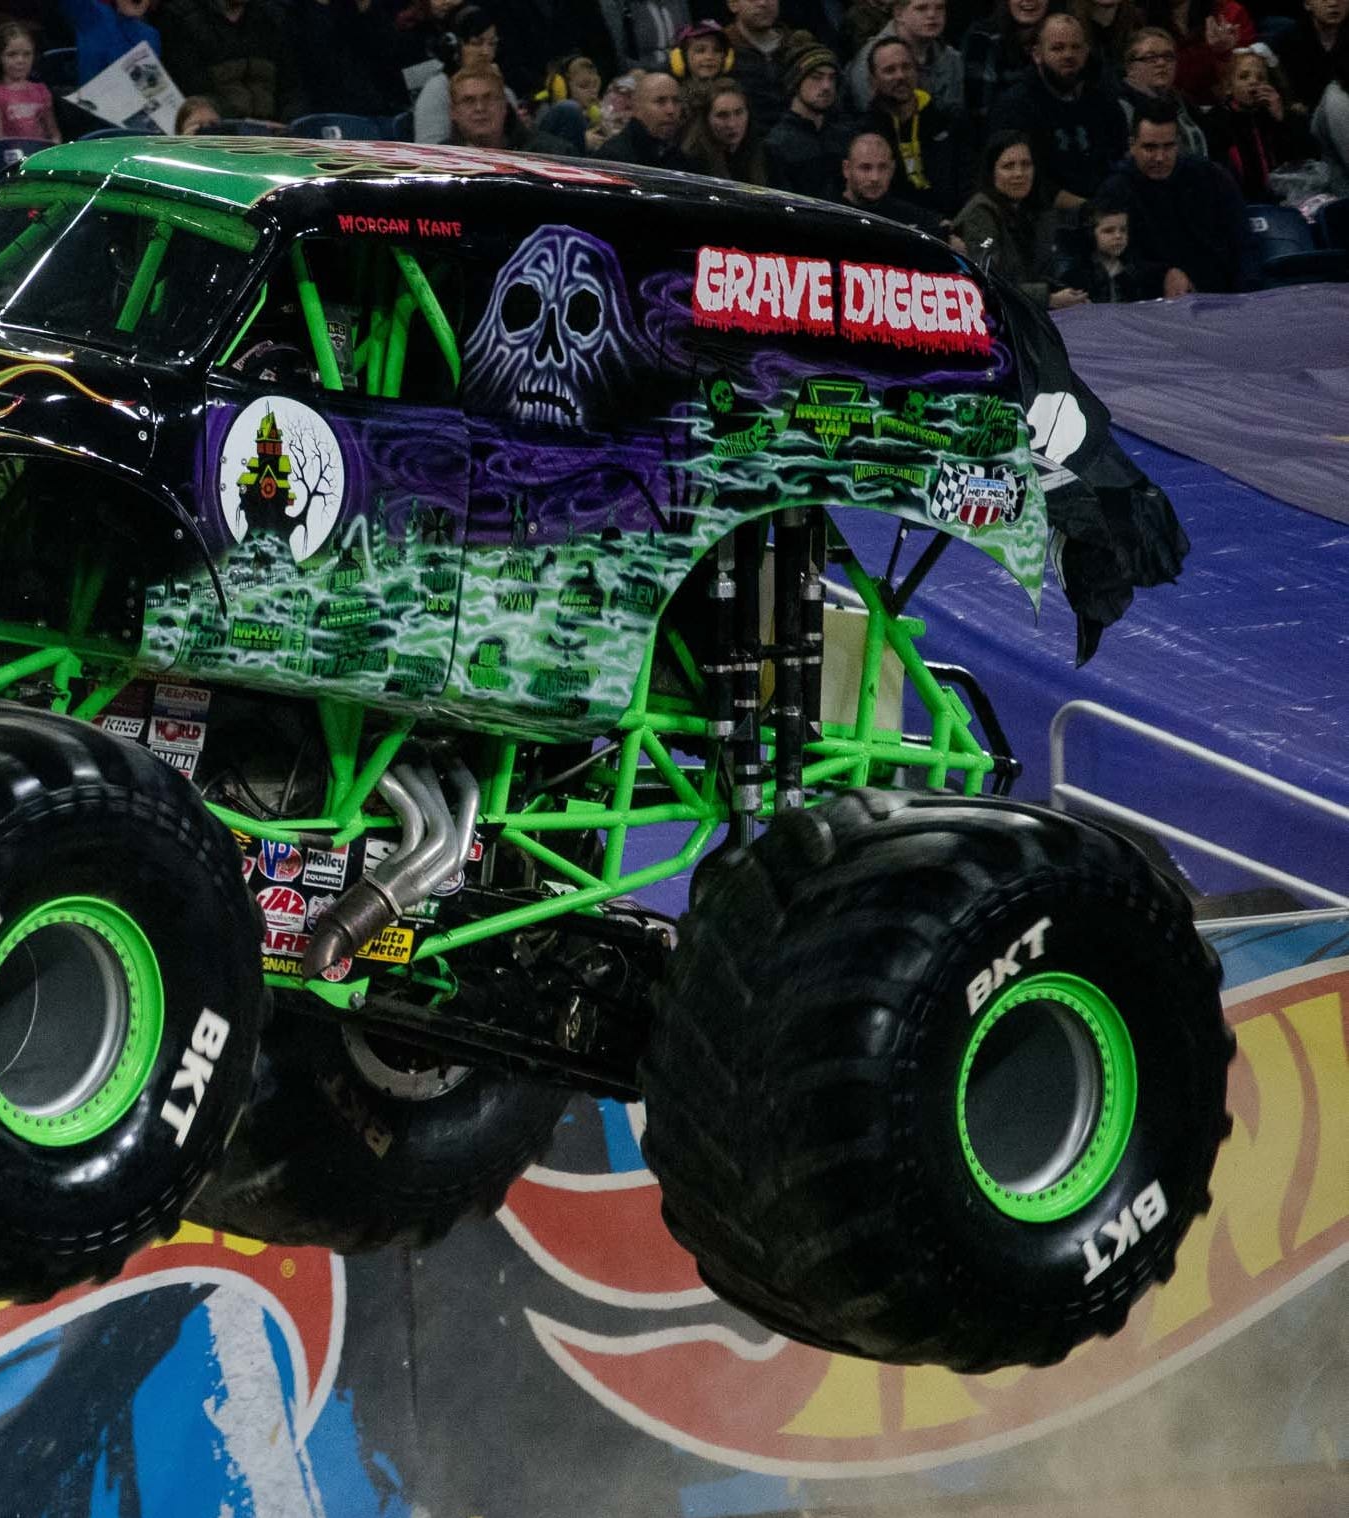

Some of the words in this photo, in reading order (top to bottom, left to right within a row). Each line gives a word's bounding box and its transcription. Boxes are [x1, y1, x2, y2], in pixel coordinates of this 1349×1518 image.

[336, 213, 410, 235] MORGAN
[416, 217, 463, 239] KANE
[694, 247, 835, 322] GRAVE
[842, 264, 989, 336] DIGGER
[795, 403, 872, 424] MONSTER
[814, 420, 851, 437] JAM
[502, 560, 534, 582] ADAM
[500, 592, 533, 610] RYAN
[104, 718, 142, 734] KING
[261, 839, 293, 879] VP
[307, 850, 346, 873] Holley
[305, 873, 342, 885] EQUIPPED
[256, 887, 305, 915] JAZ
[369, 942, 408, 957] Meter
[965, 916, 1053, 1016] BKT
[160, 1007, 230, 1148] BKT
[1083, 1179, 1168, 1285] BKT
